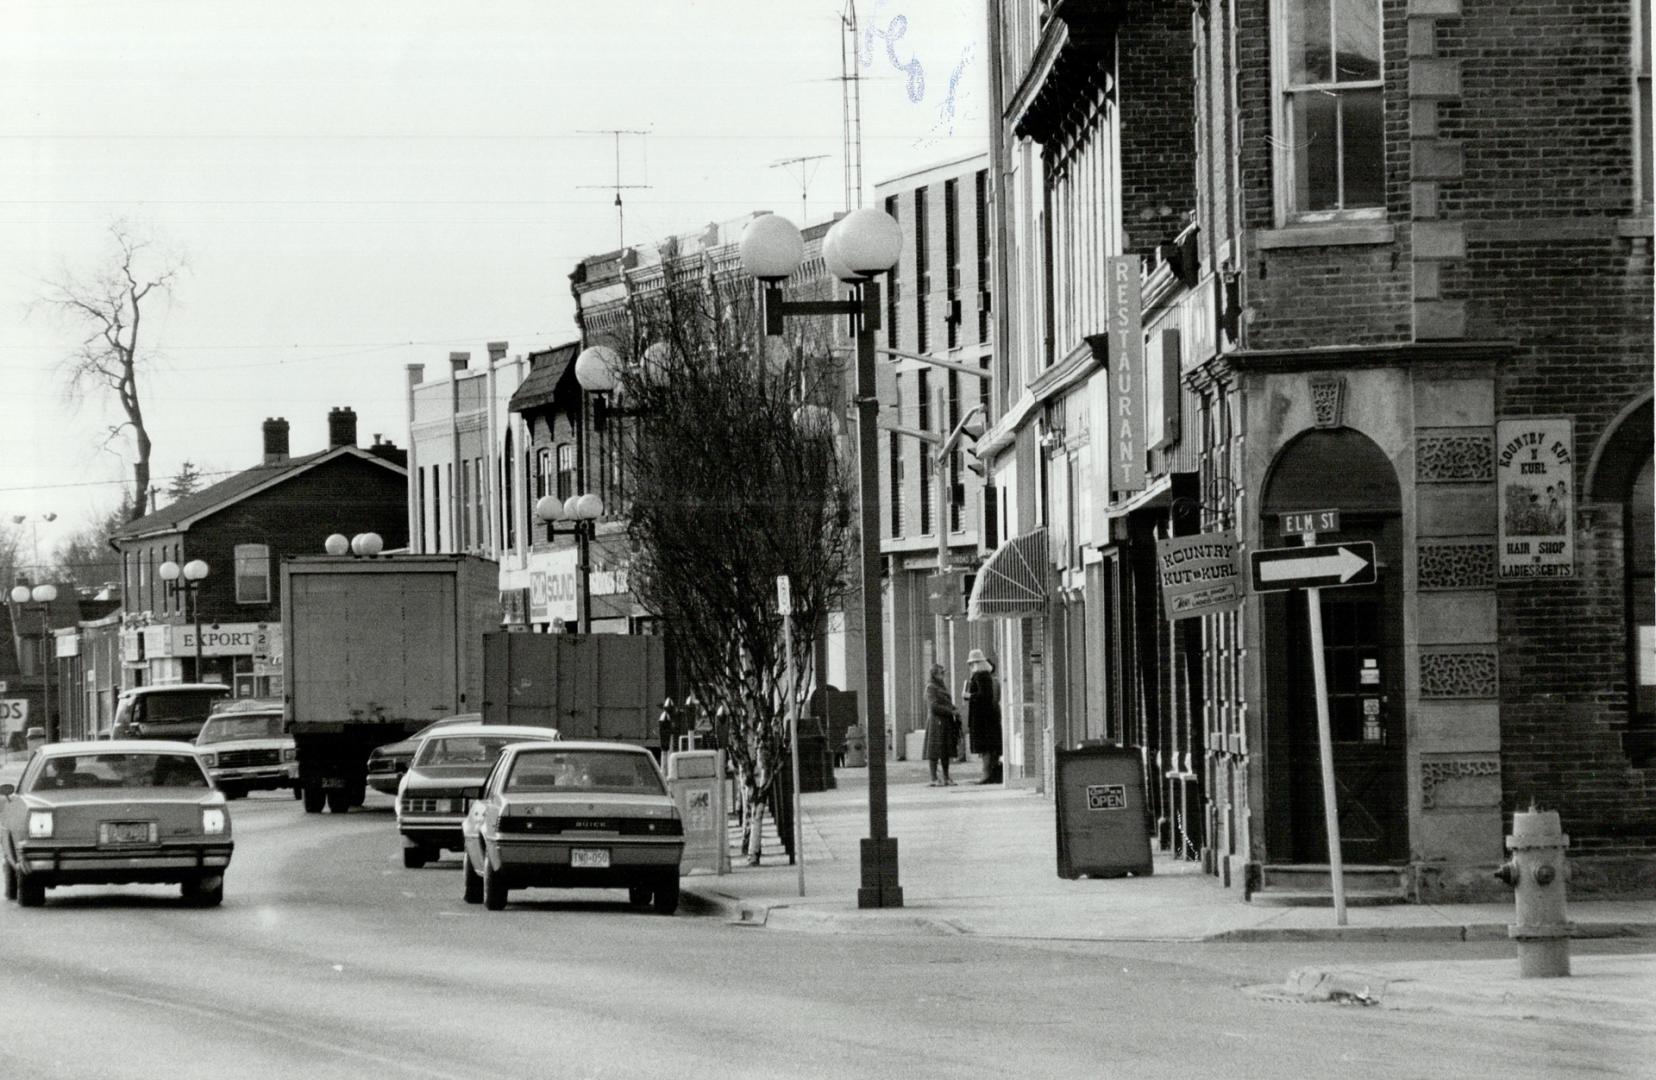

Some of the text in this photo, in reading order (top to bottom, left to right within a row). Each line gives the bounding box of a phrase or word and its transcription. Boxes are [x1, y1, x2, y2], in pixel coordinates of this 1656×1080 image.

[1115, 262, 1133, 483] RESTAURANT
[1498, 431, 1571, 468] KOUNTRY KUT
[1520, 462, 1547, 475] KURL
[1286, 512, 1335, 532] ELM ST
[1163, 544, 1233, 568] KOUNTRY
[1506, 541, 1566, 555] HAIR SHOP
[1163, 569, 1192, 586] KUT
[1201, 563, 1238, 580] KURL
[184, 632, 253, 647] EXPORT
[258, 634, 266, 644] 2
[1091, 795, 1123, 807] OPEN
